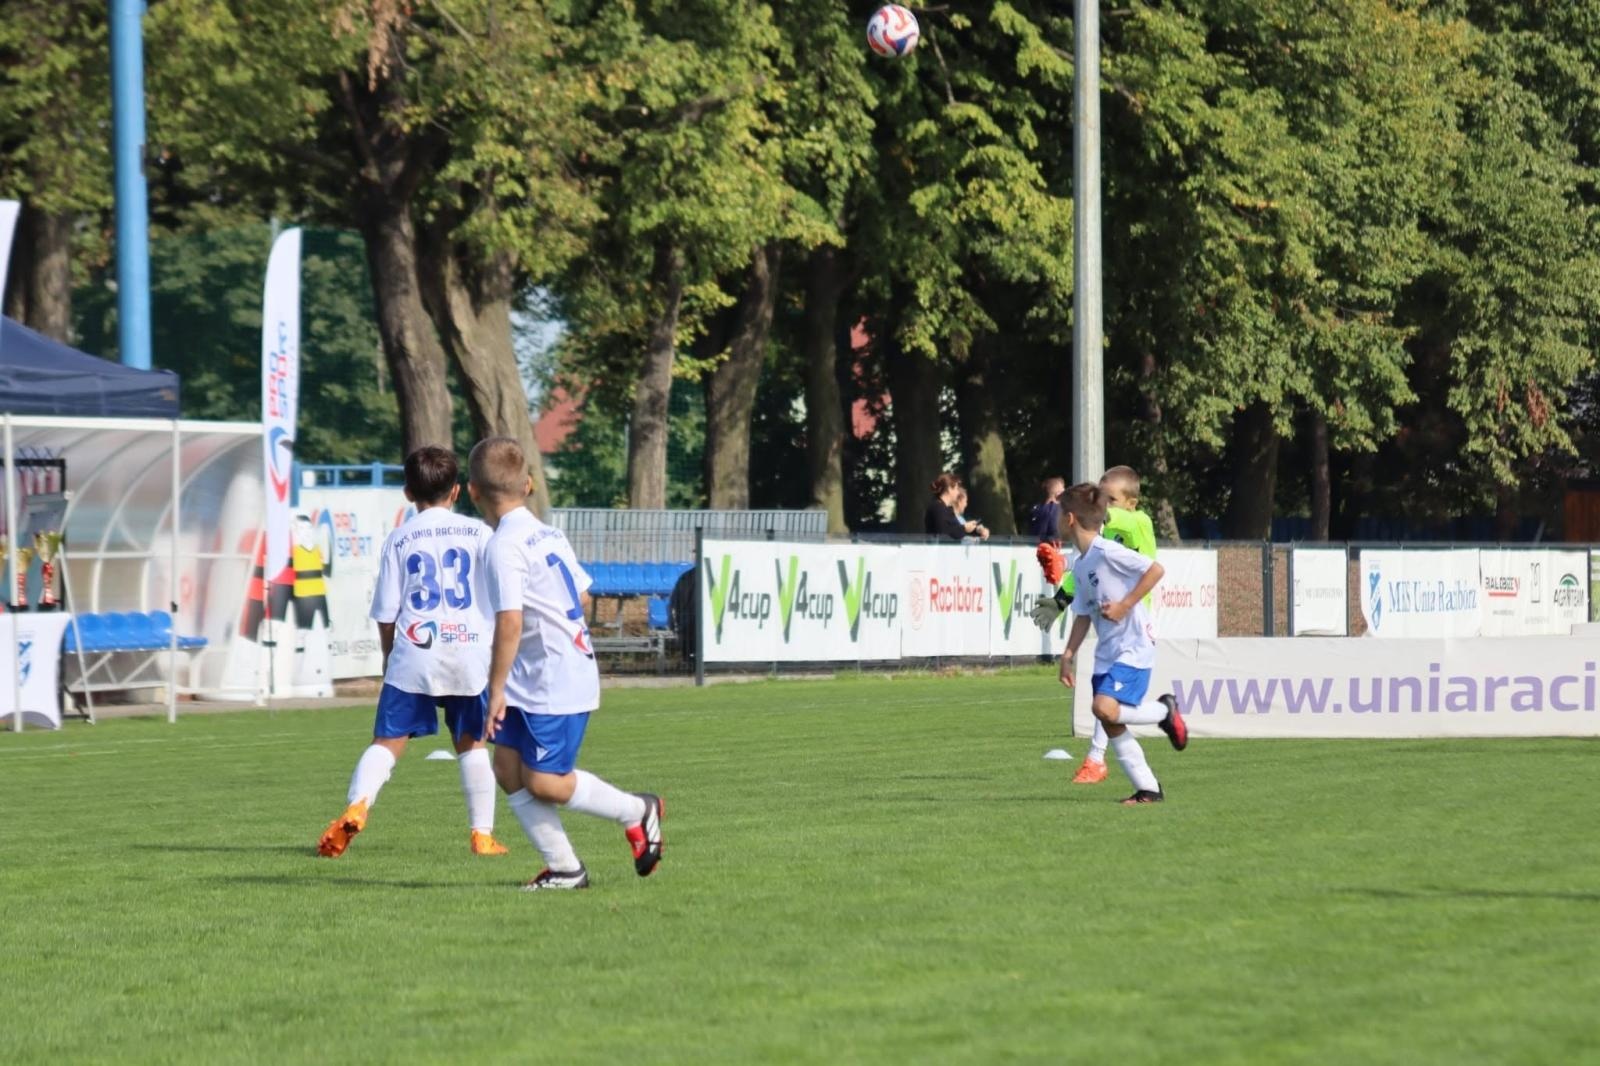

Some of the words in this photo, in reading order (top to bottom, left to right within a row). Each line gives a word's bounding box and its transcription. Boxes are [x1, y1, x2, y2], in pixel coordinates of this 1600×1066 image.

[406, 546, 472, 612] 33
[929, 576, 984, 614] Racibórz
[1413, 581, 1435, 613] Unia
[440, 623, 467, 633] PRO
[440, 632, 480, 643] SPORT
[1171, 661, 1597, 715] www.uniaraci
